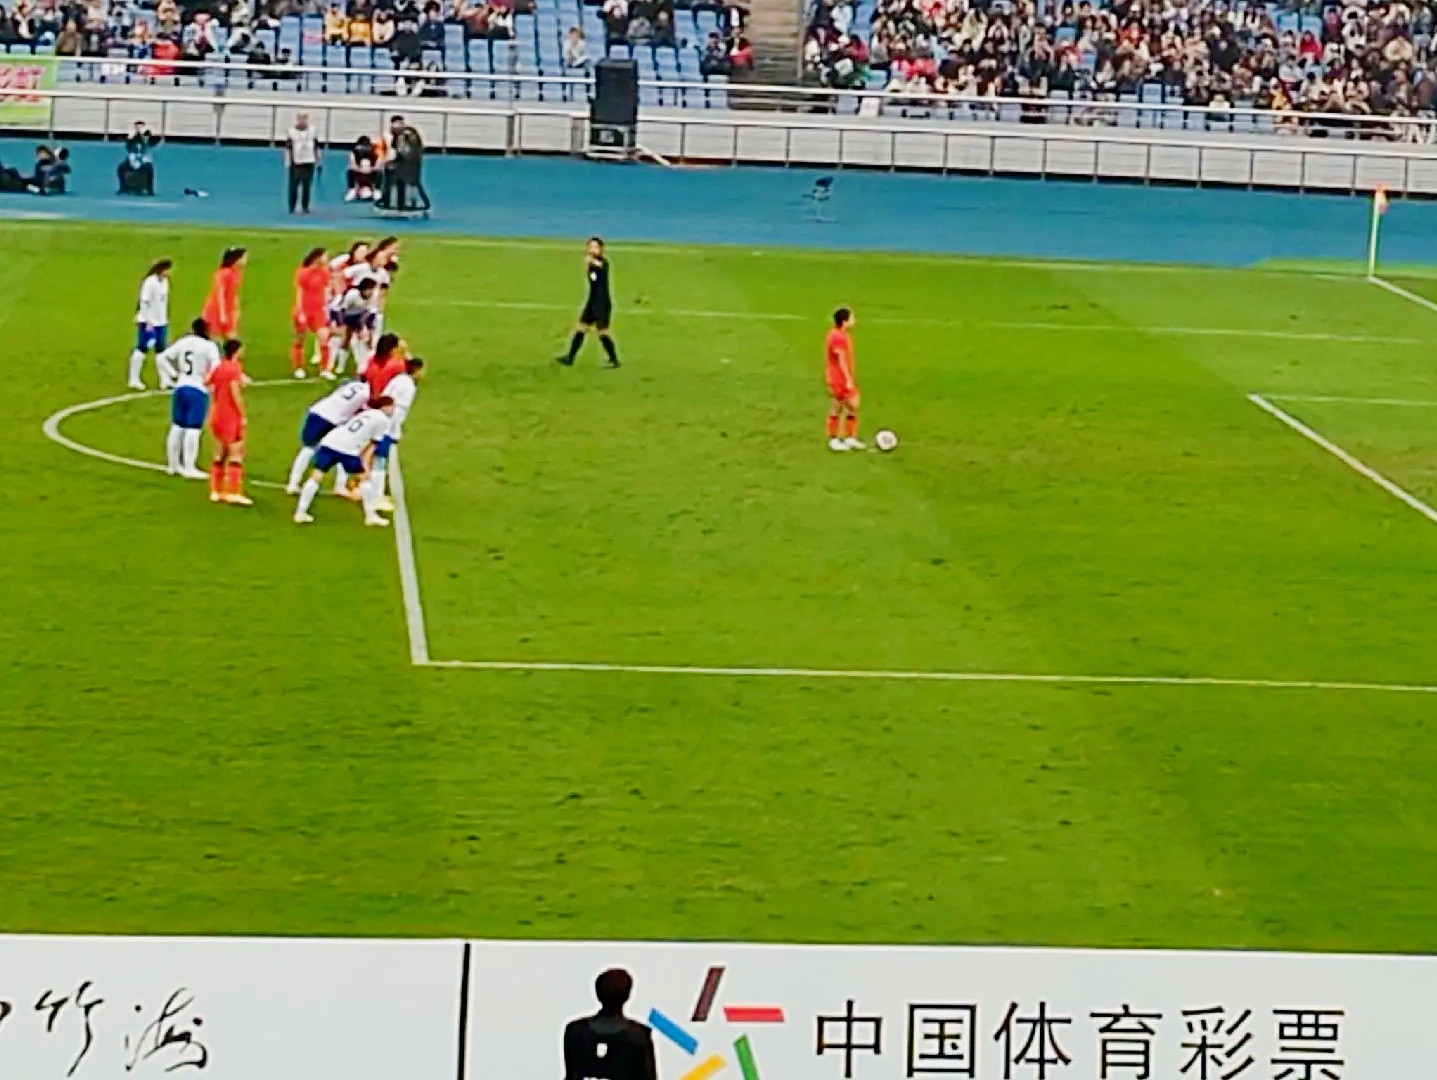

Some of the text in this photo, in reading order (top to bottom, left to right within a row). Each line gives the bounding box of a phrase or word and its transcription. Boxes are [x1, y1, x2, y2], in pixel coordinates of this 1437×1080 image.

[184, 350, 193, 376] 5
[815, 999, 1346, 1080] 中国体育彩票
